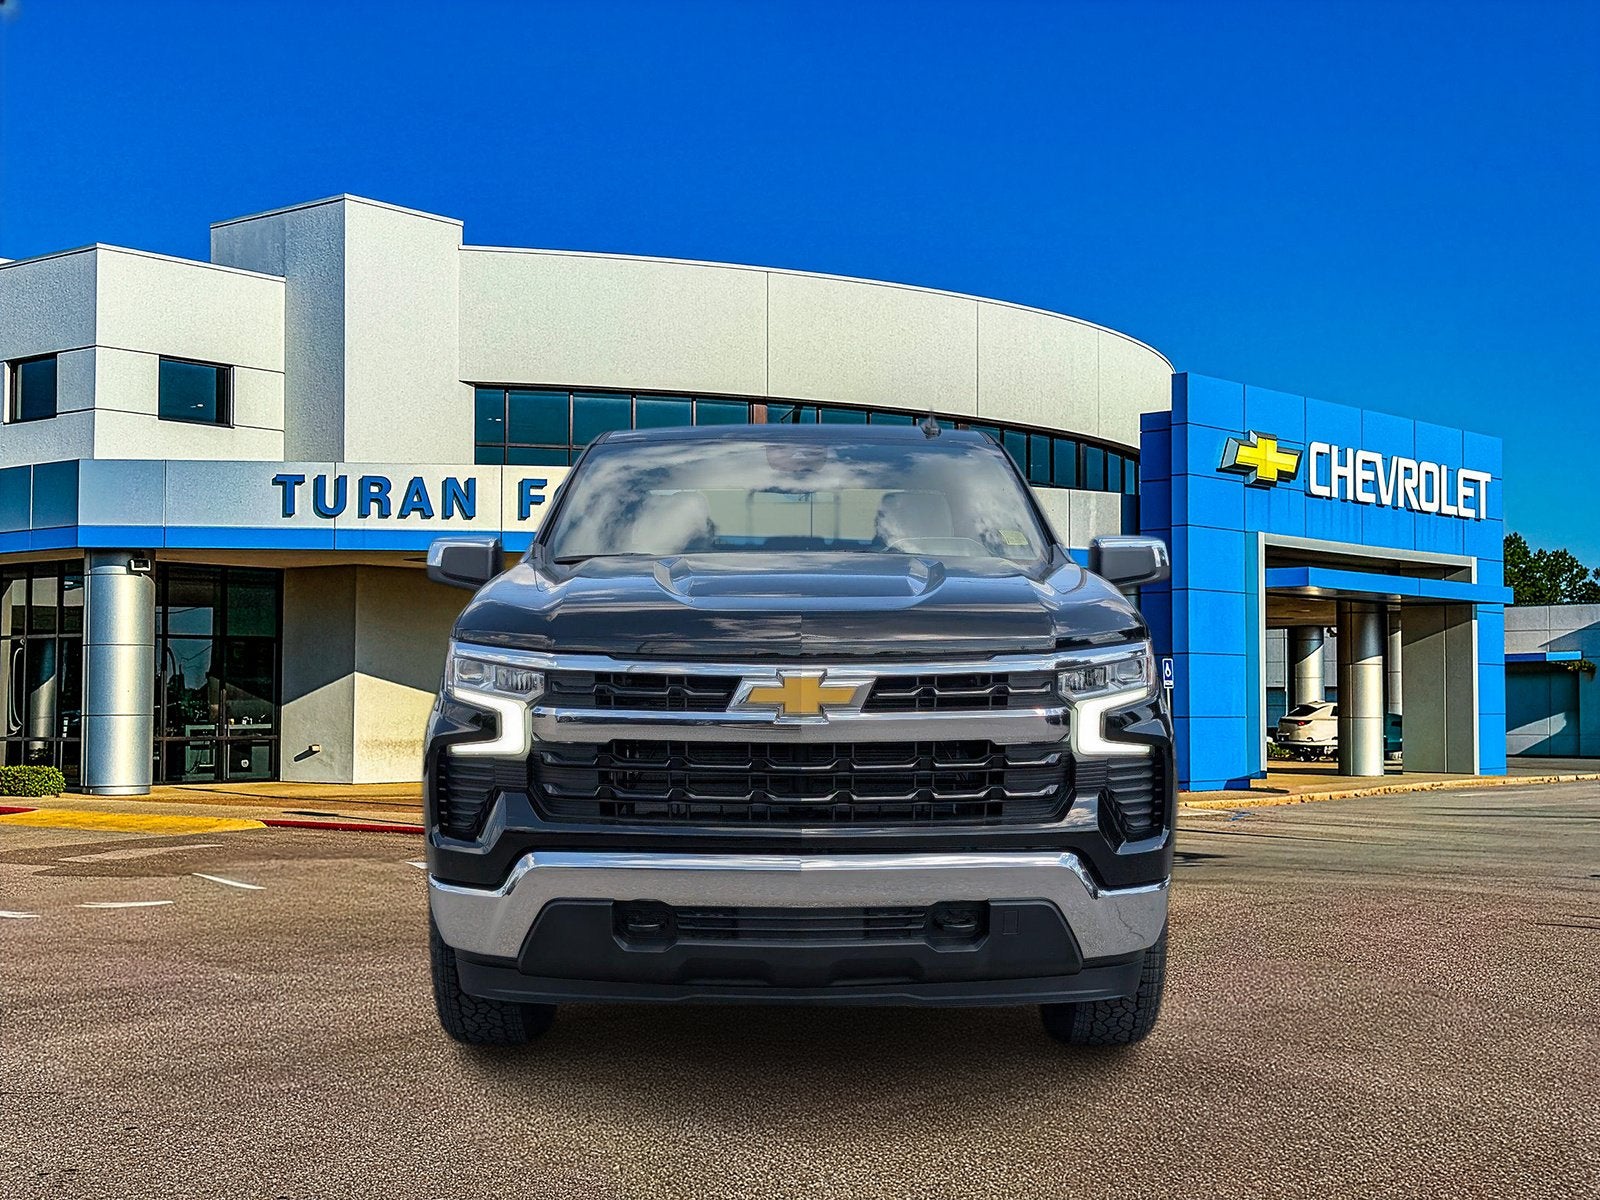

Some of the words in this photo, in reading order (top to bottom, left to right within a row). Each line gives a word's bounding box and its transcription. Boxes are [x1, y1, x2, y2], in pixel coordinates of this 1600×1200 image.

[272, 473, 477, 520] TURAN
[517, 478, 561, 521] F
[1308, 441, 1492, 520] CHEVROLET
